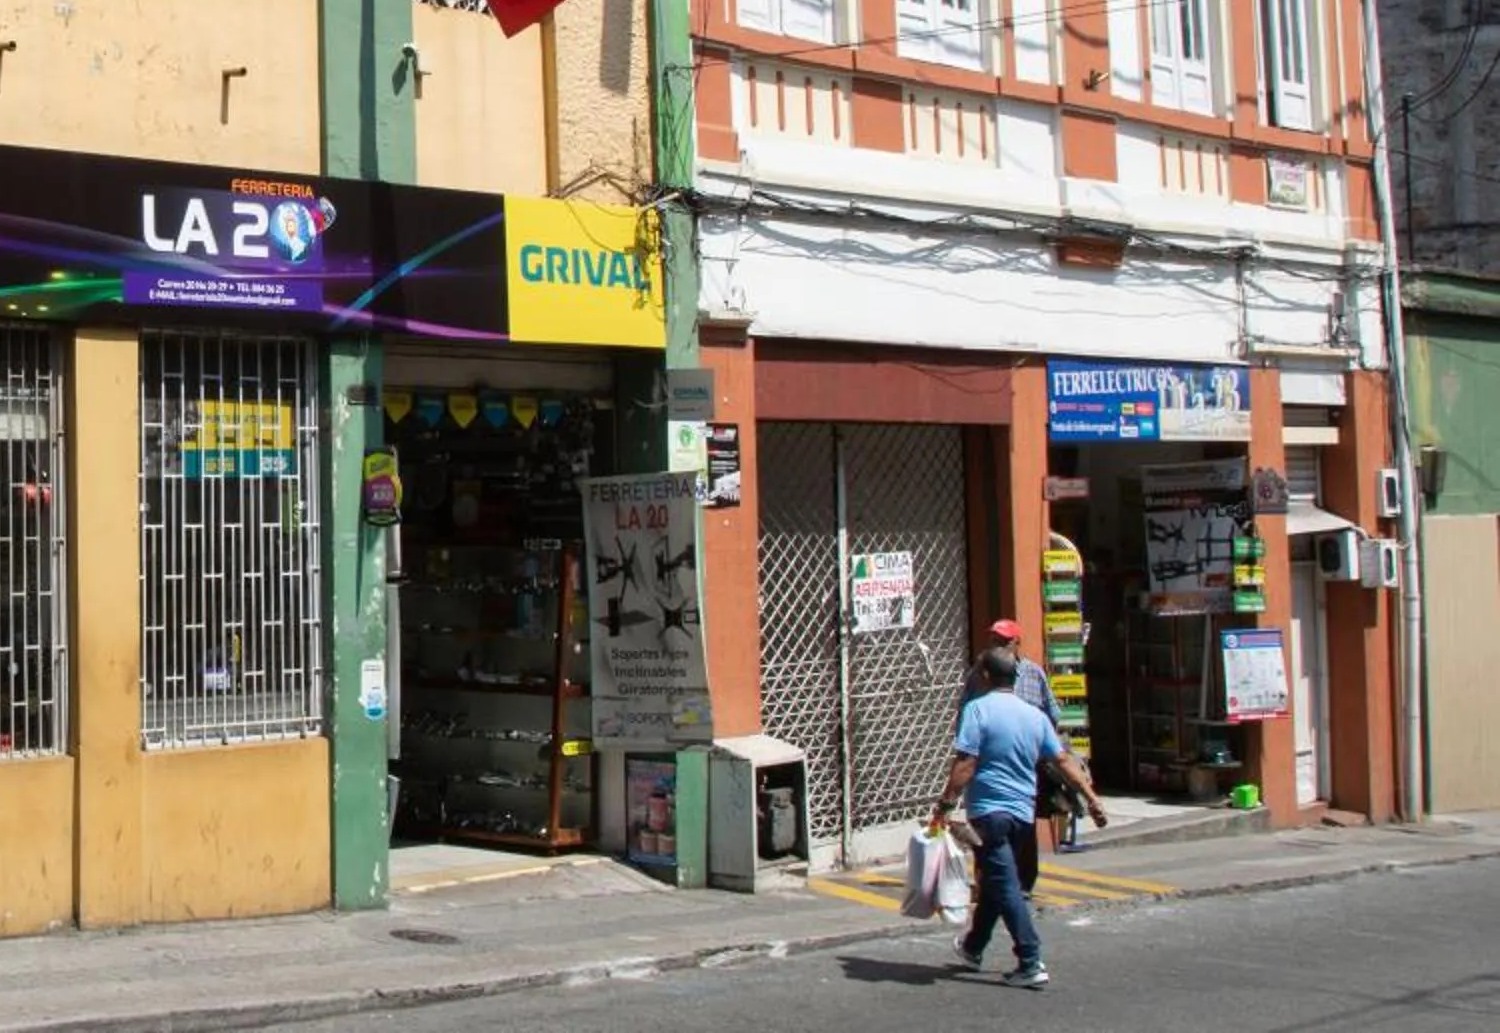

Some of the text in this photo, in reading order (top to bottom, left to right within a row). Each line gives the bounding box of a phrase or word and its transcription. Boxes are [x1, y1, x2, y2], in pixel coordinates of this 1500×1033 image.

[231, 178, 315, 199] FERRETERIA
[142, 194, 219, 256] LA
[520, 244, 651, 291] GRIVAL
[590, 478, 692, 503] FERRETERIA
[615, 503, 669, 531] LA 20
[615, 665, 687, 678] Inclinables
